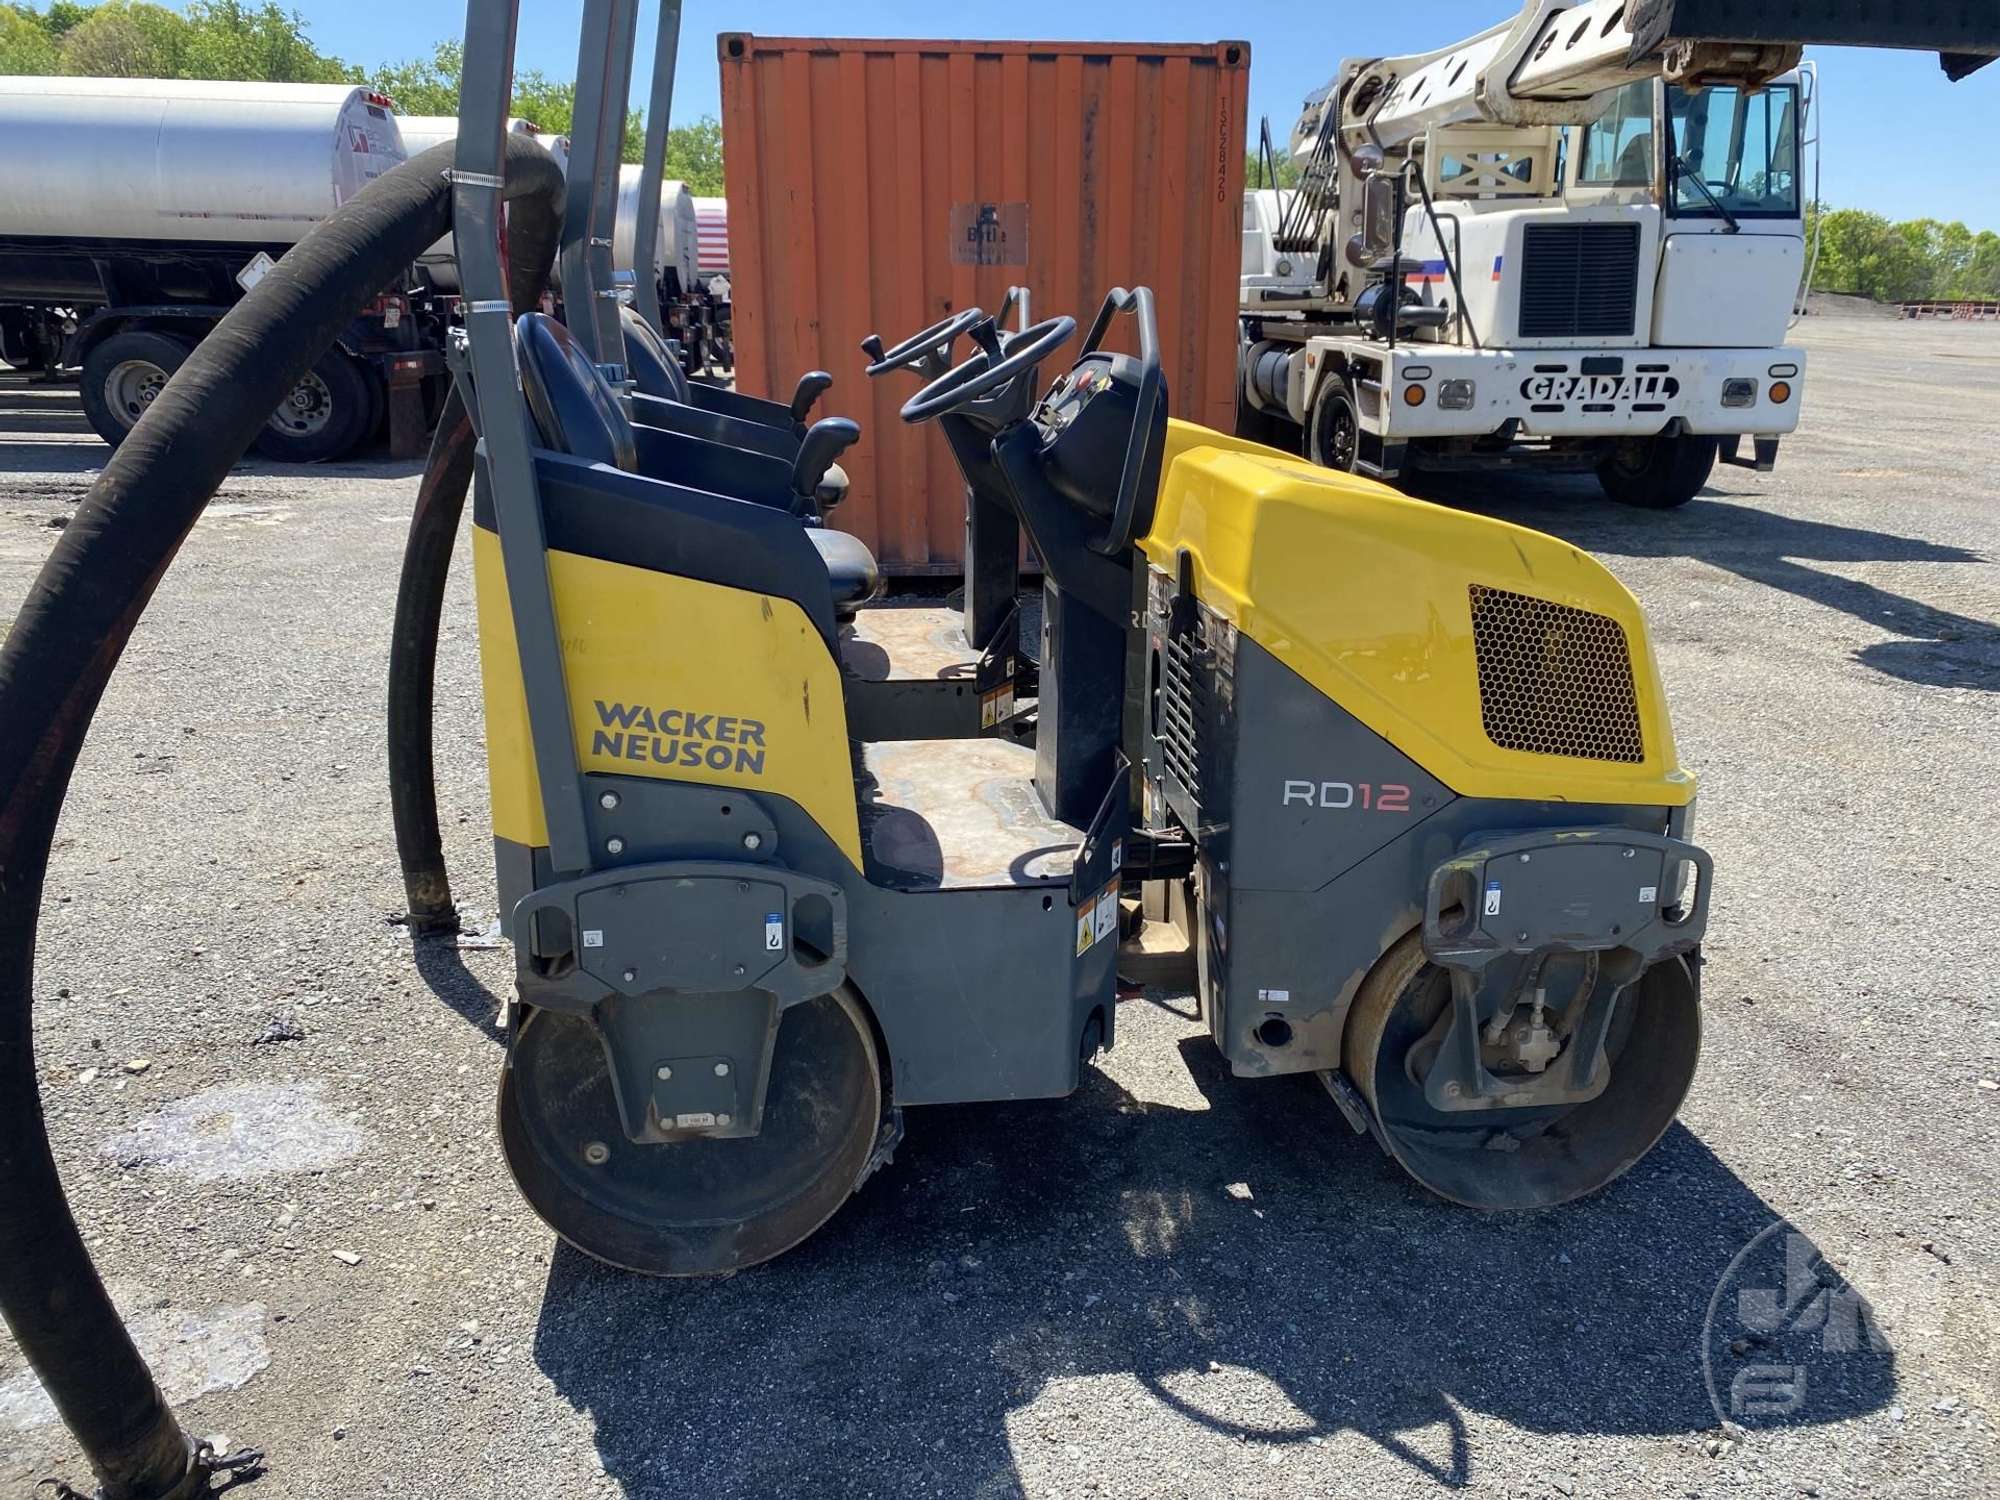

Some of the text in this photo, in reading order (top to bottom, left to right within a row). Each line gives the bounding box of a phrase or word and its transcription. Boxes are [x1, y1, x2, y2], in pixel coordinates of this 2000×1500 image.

[1527, 377, 1670, 400] GRADALL
[594, 700, 766, 746] WACKER
[592, 730, 766, 774] NEUSON
[1283, 780, 1410, 811] RD12
